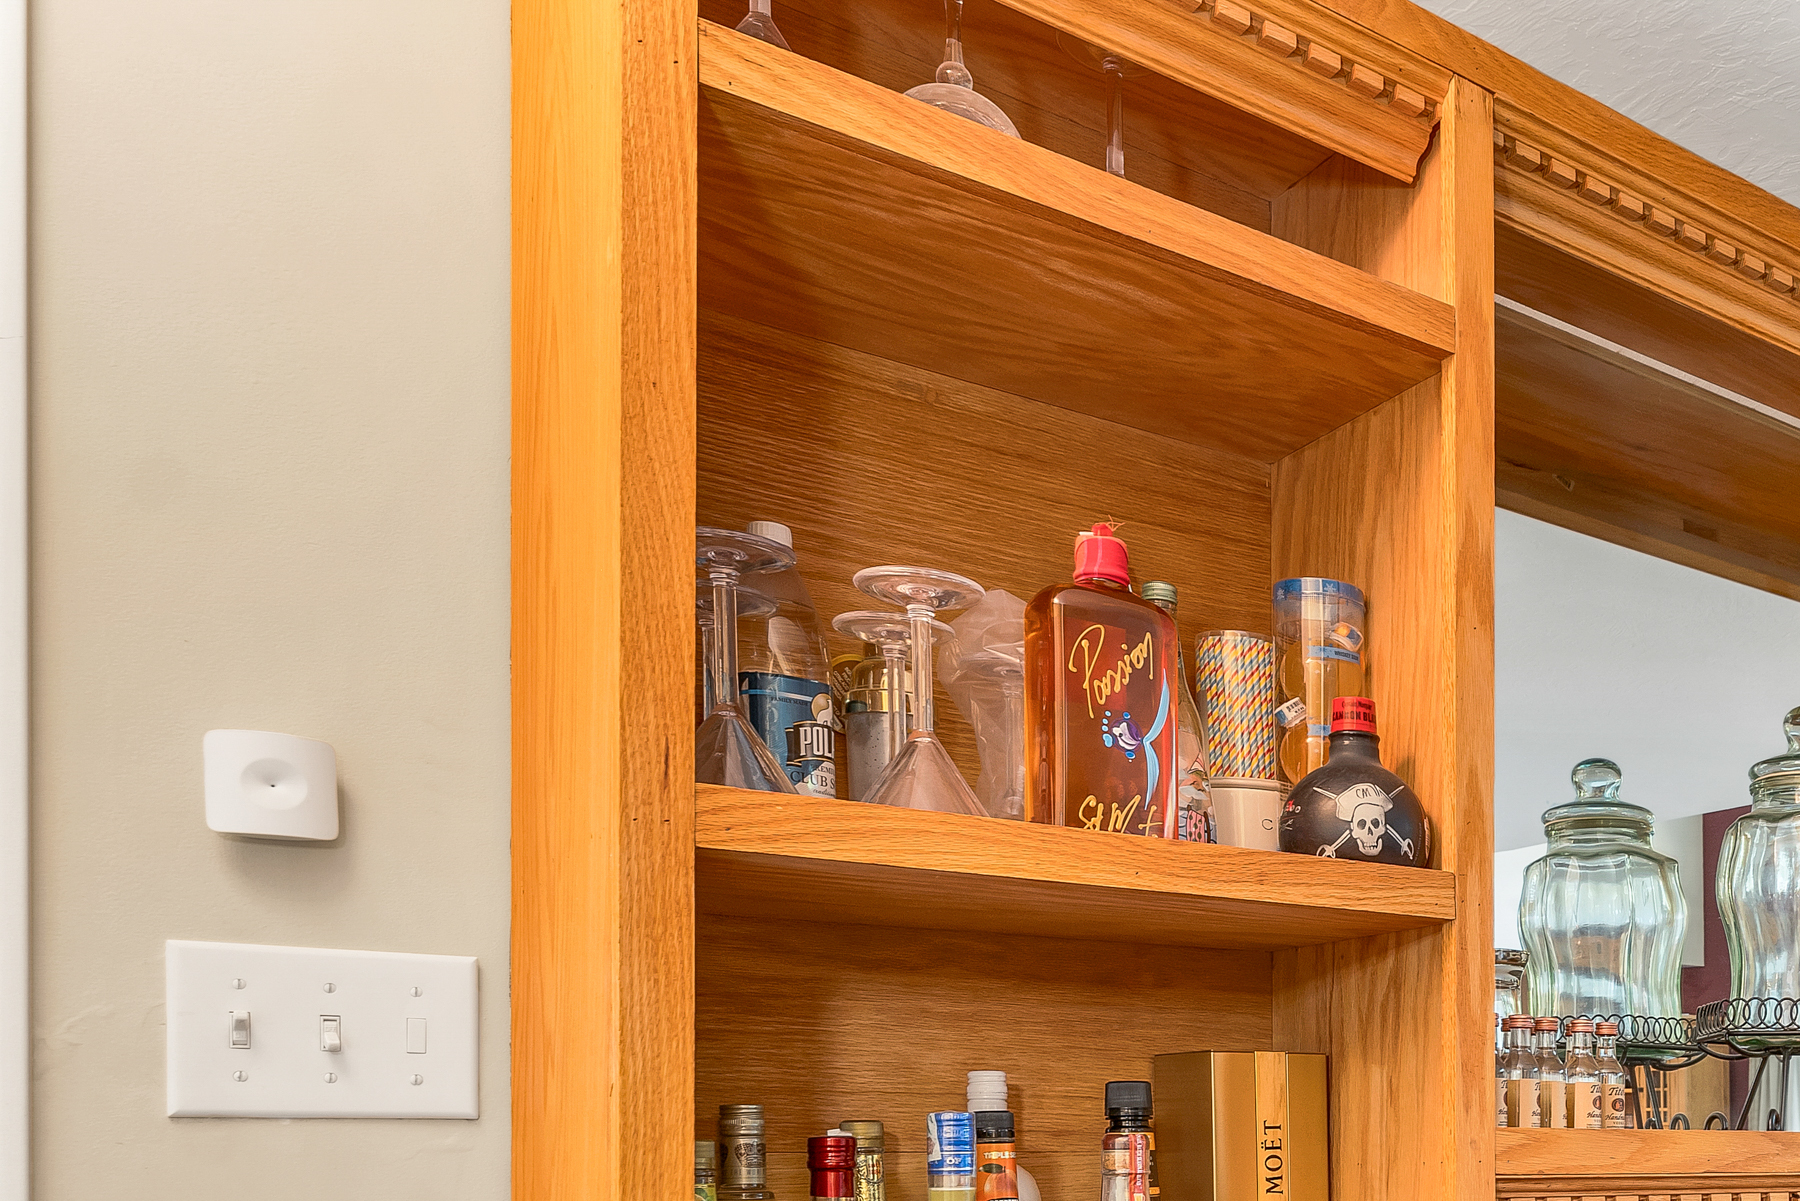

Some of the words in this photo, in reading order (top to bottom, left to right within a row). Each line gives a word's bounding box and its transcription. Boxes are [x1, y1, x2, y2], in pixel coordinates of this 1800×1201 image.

[1069, 624, 1154, 719] Passion
[800, 726, 835, 760] POL
[790, 771, 828, 788] CLUB
[1261, 1120, 1283, 1194] MOËT
